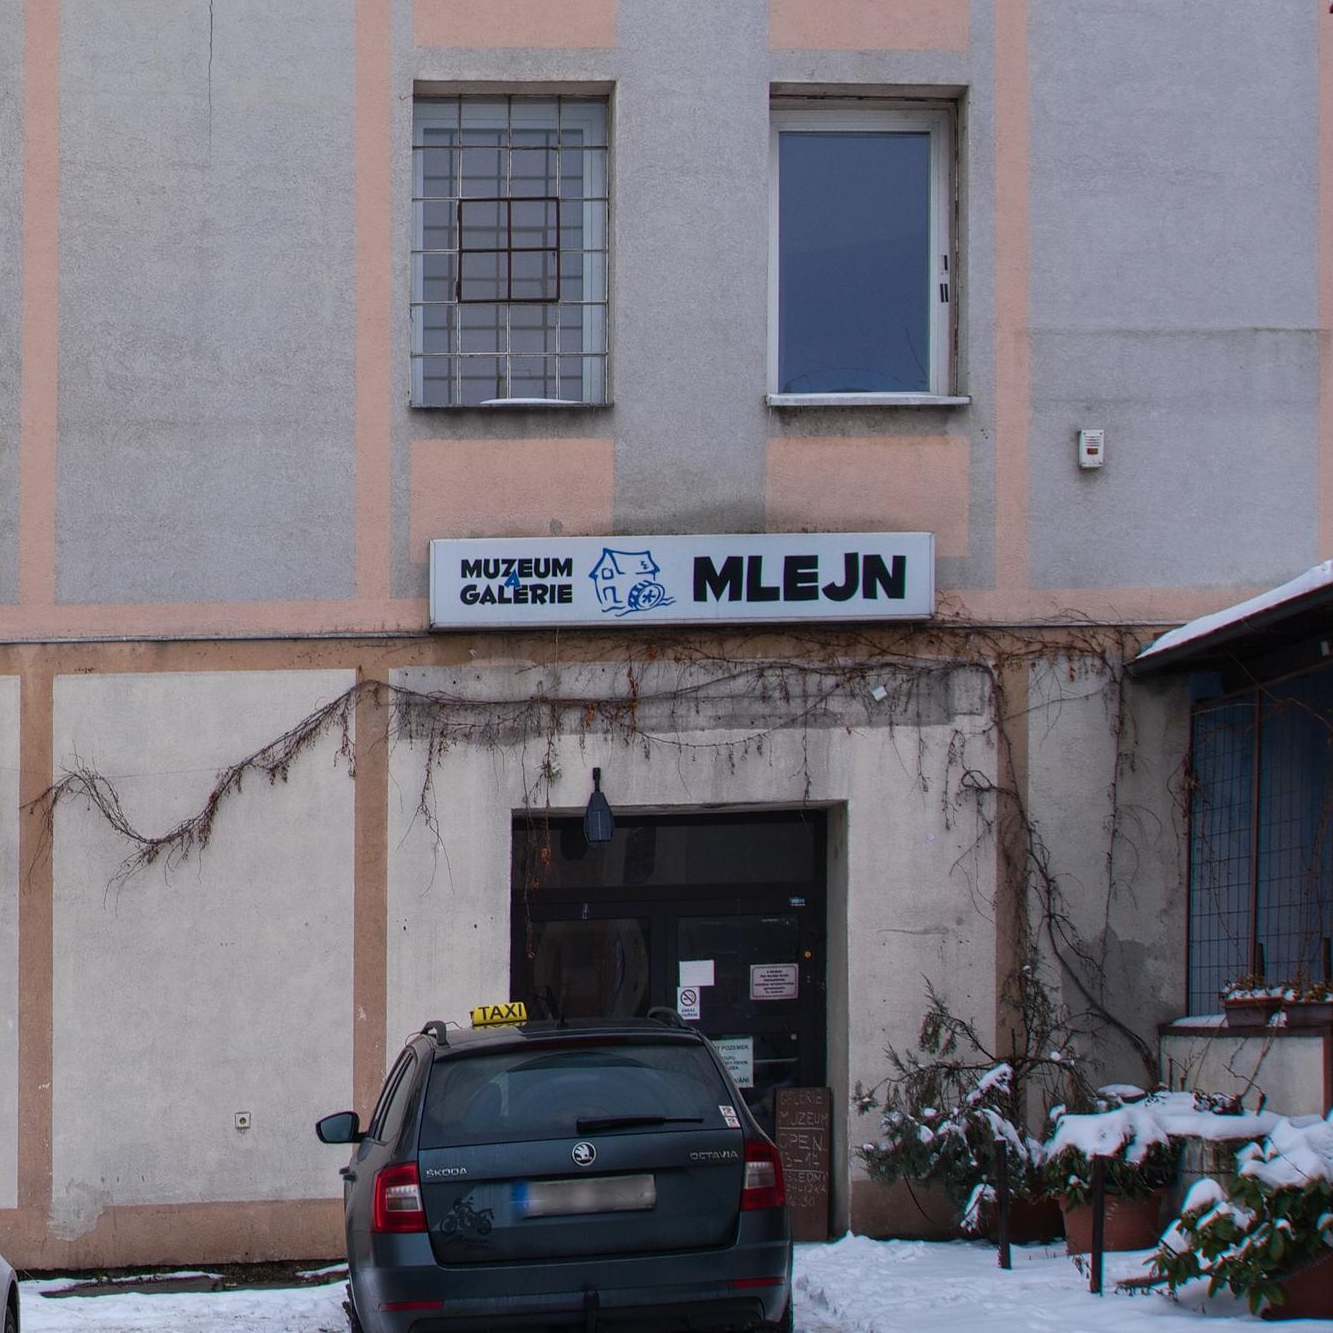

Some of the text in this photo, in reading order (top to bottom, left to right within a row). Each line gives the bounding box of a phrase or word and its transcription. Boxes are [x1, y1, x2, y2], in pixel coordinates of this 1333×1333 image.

[460, 557, 573, 580] MUZEUM
[693, 552, 907, 602] MLEJN
[504, 569, 521, 589] A
[460, 583, 573, 605] GALERIE
[478, 1003, 523, 1021] TAXI
[779, 1110, 829, 1127] MUZEUM
[779, 1133, 823, 1152] OPEN
[690, 1150, 739, 1160] OCTAVIA
[426, 1167, 468, 1178] ŠKODA
